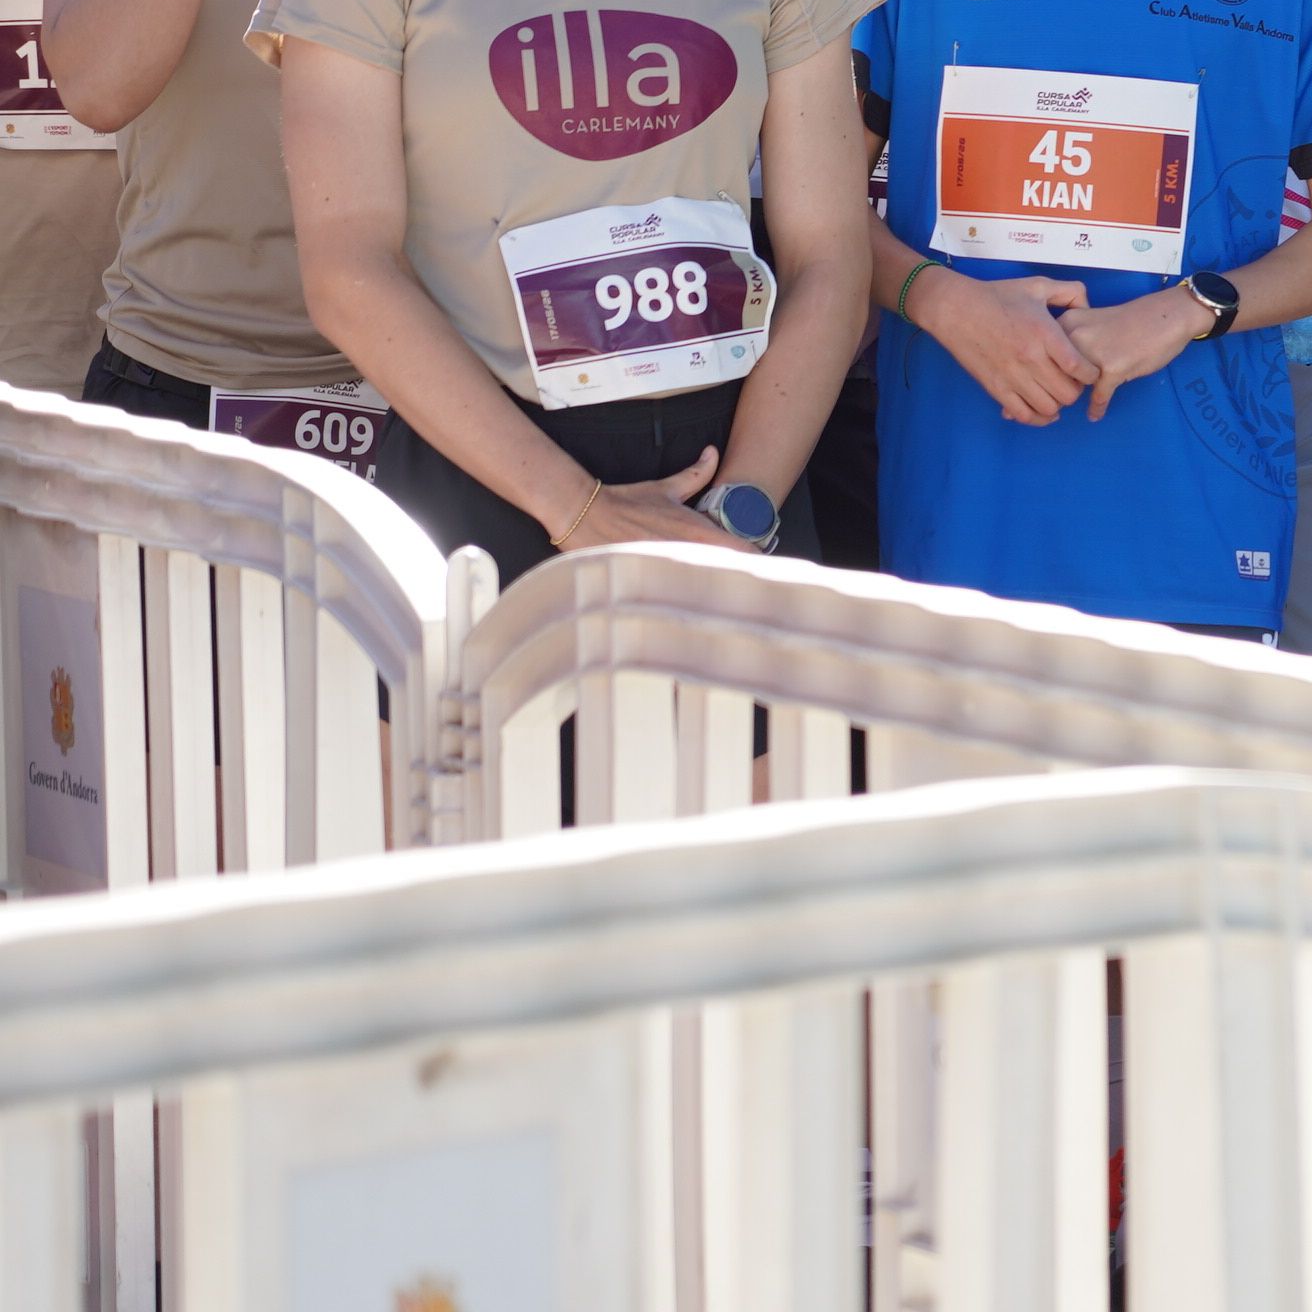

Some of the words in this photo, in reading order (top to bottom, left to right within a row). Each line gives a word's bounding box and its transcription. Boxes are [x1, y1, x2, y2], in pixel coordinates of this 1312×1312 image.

[1148, 0, 1176, 17] Club
[1178, 4, 1230, 27] Atletisme
[1255, 19, 1295, 43] Andorra
[517, 9, 682, 112] illa
[1037, 91, 1071, 100] CURSA
[1037, 99, 1083, 108] POPULAR
[561, 114, 681, 134] CARLEMANY
[1028, 130, 1094, 176] 45
[1165, 159, 1180, 190] KM.
[1021, 179, 1094, 211] KIAN
[1164, 193, 1176, 204] 5
[611, 226, 656, 240] POPULAR
[595, 260, 708, 331] 988
[750, 298, 762, 306] 5
[295, 409, 374, 456] 609
[29, 761, 58, 791] Govern
[60, 770, 98, 805] d'Andorra
